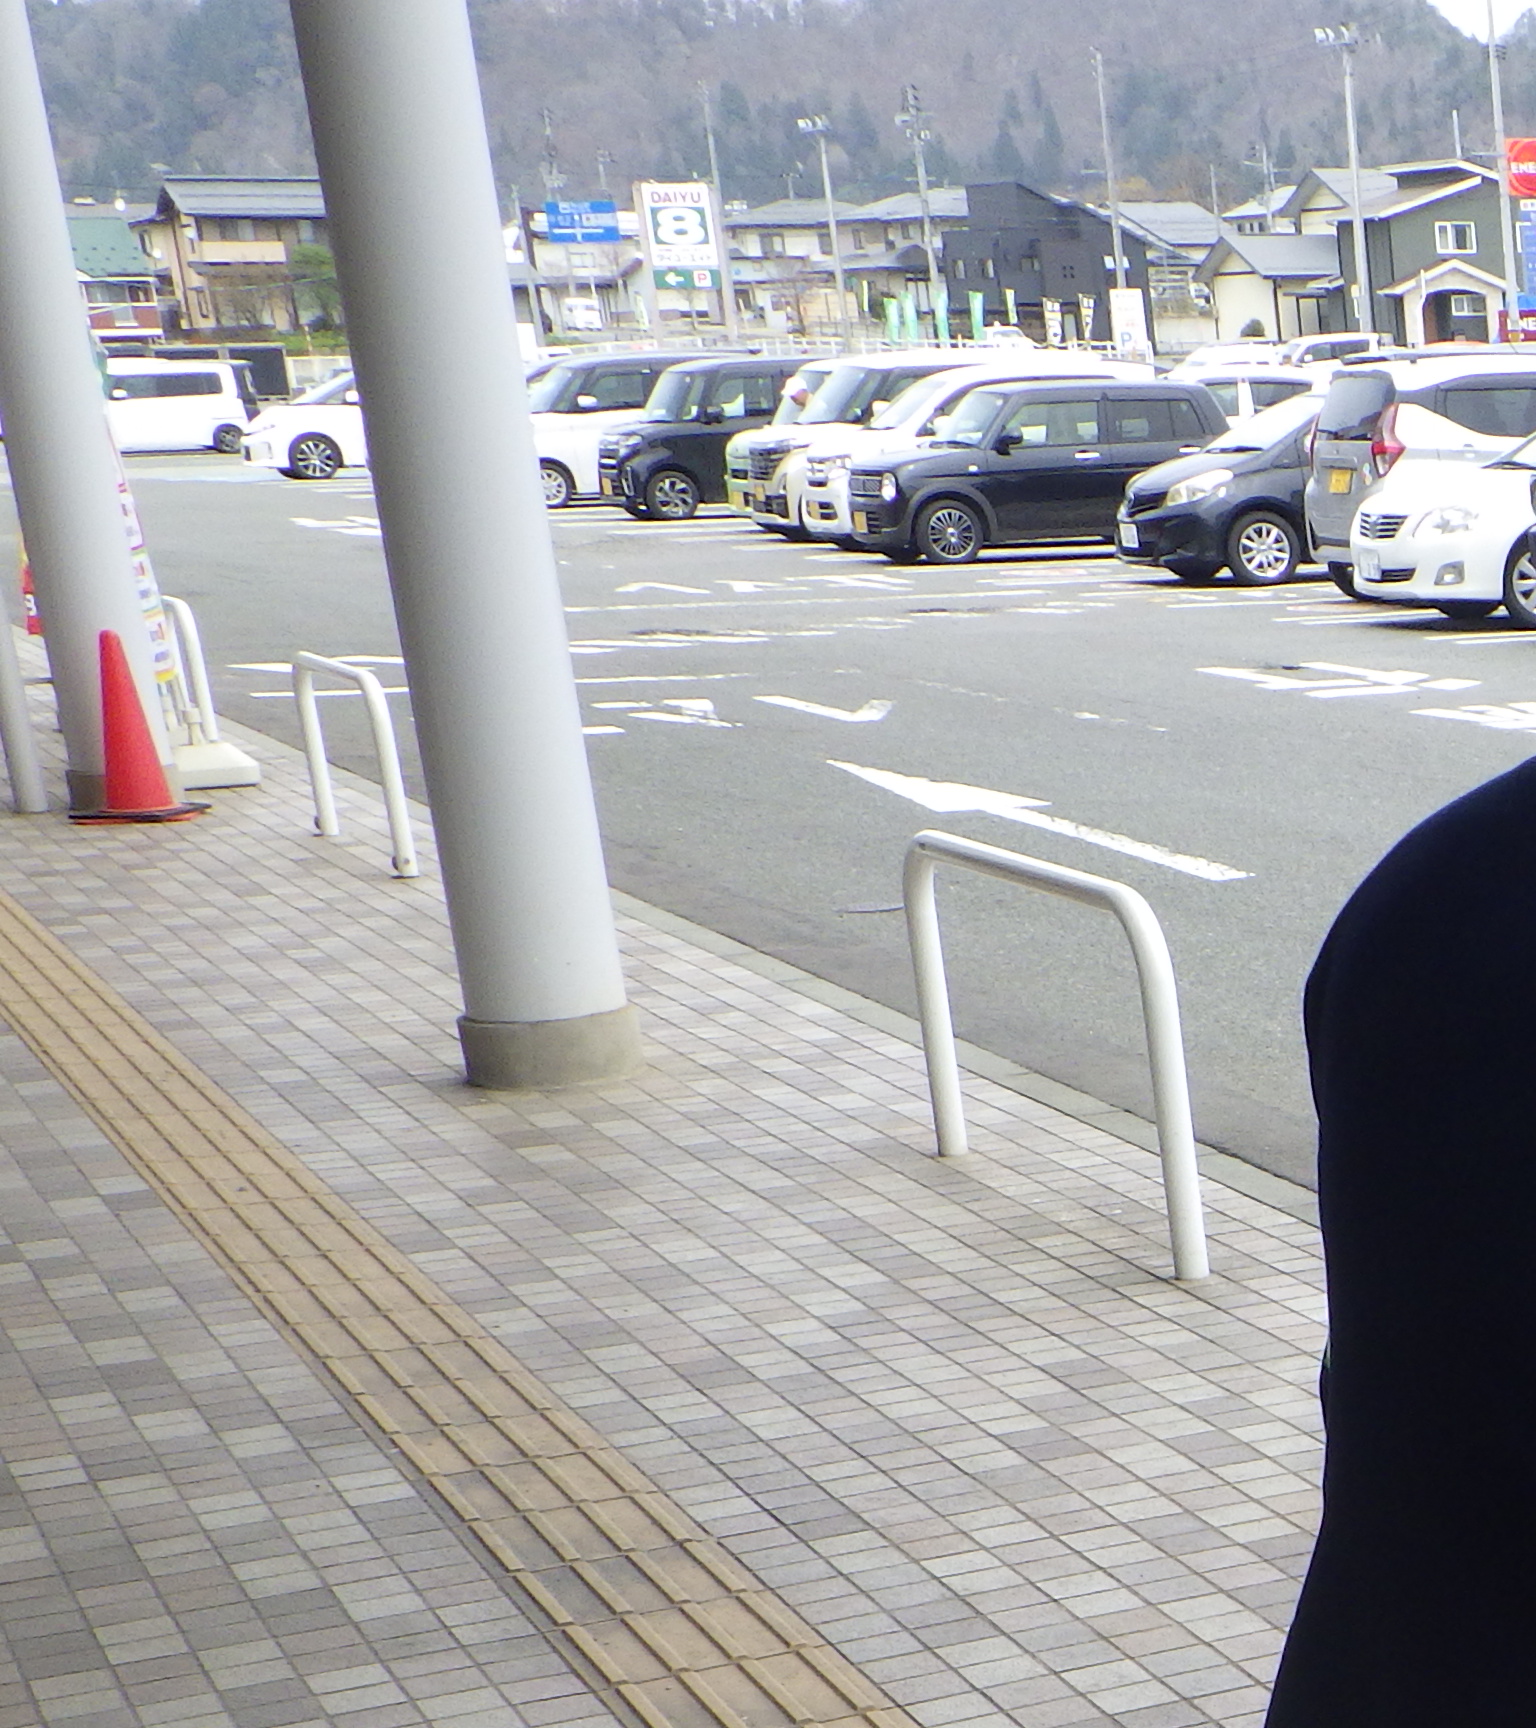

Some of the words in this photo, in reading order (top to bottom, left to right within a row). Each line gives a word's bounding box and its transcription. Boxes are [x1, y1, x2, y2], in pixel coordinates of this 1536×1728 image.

[650, 191, 701, 203] DAIYU
[656, 208, 706, 245] 8
[697, 273, 708, 283] P
[1119, 331, 1133, 348] P
